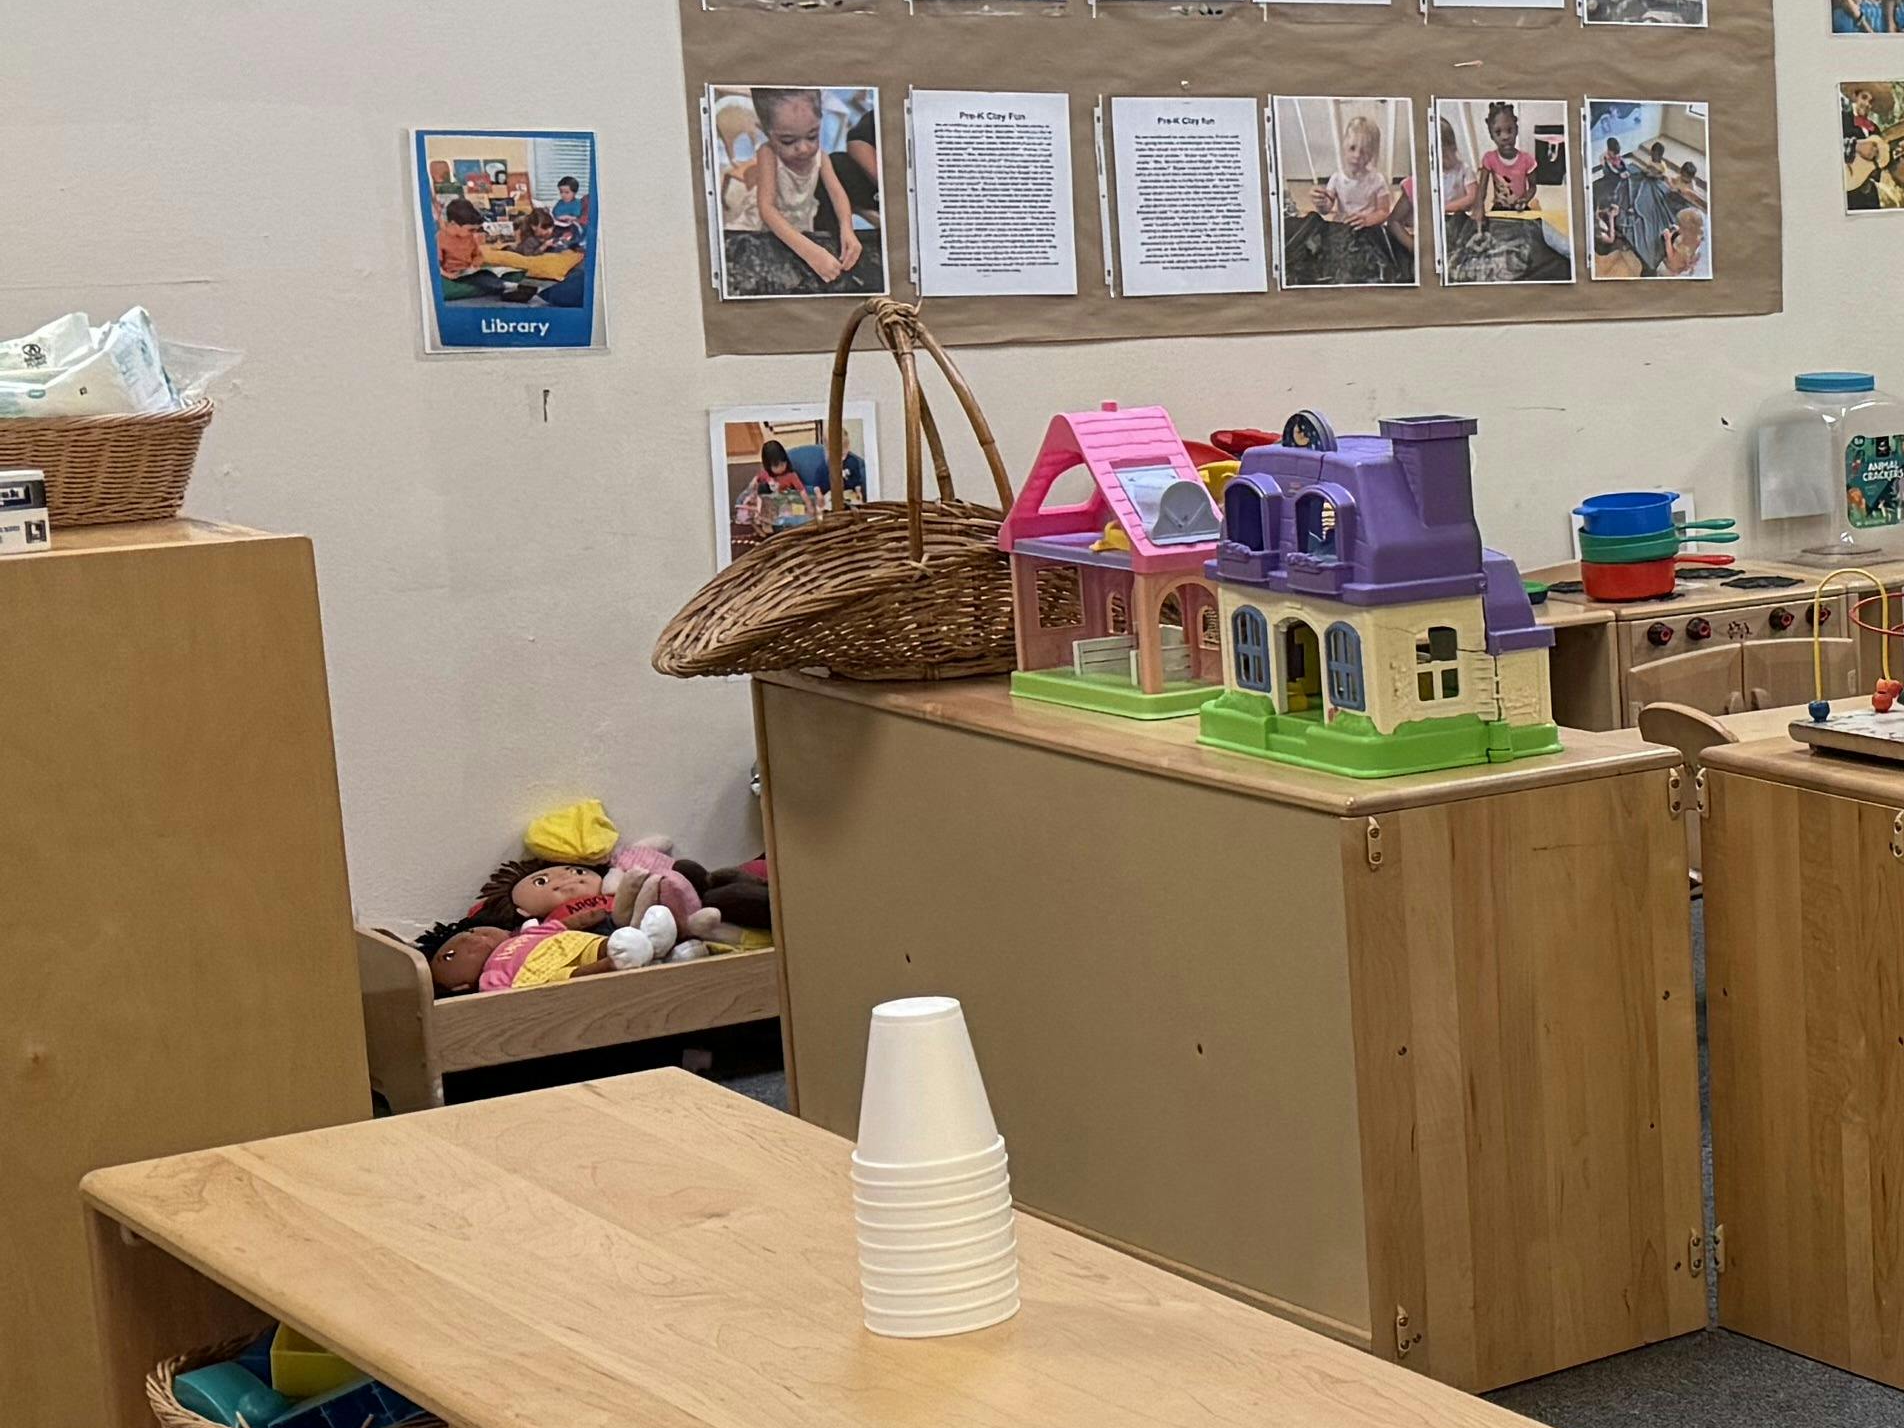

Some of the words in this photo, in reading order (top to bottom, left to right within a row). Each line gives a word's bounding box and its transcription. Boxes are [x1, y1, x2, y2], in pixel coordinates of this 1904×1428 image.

[986, 111, 1006, 122] Clay
[1008, 112, 1026, 121] Fun
[1182, 117, 1200, 126] Clay
[481, 318, 550, 337] Library
[1868, 460, 1899, 471] ANIMAL
[1862, 468, 1904, 481] CRACKERS
[565, 894, 609, 915] Angry
